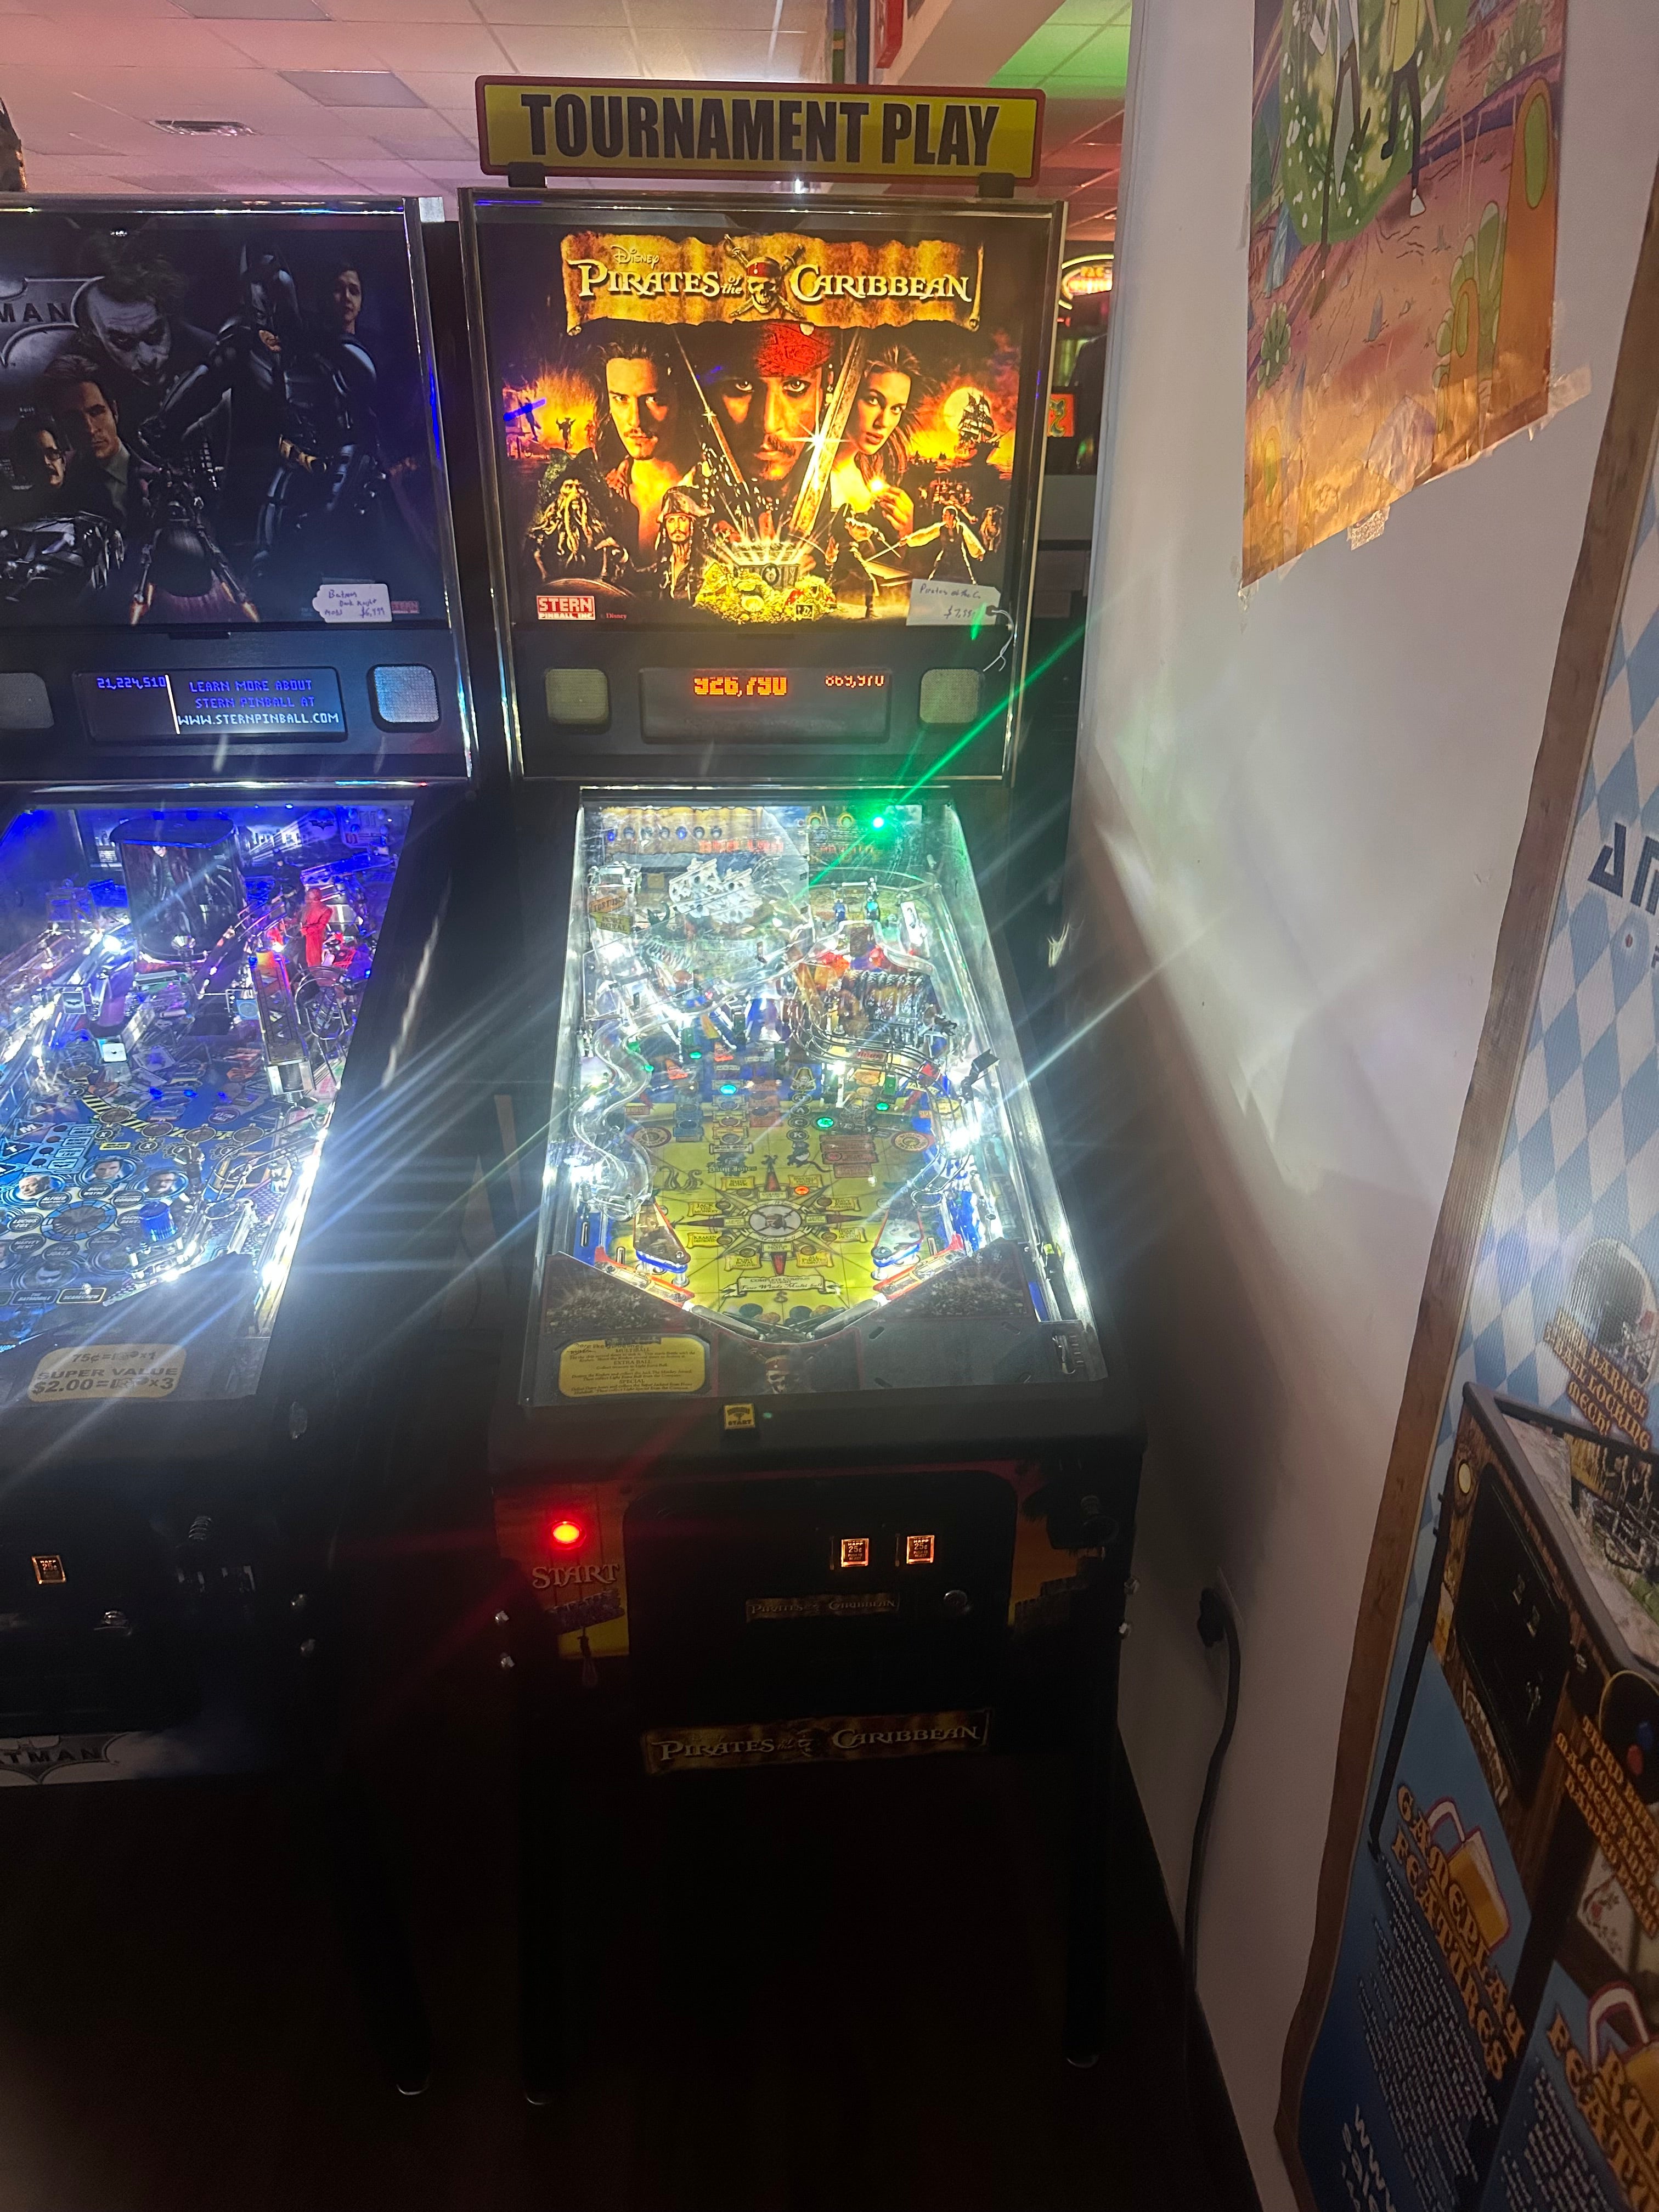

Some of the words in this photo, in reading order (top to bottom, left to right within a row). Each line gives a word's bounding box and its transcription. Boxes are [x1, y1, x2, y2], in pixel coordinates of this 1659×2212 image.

[521, 93, 870, 163] TOURNAMENT
[882, 103, 999, 166] PLAY
[566, 259, 720, 297] PIRATES
[721, 283, 742, 295] the
[788, 264, 971, 302] CARIBBEAN
[539, 597, 592, 612] STERN
[97, 676, 166, 690] 21,224,510
[189, 680, 230, 693] LEARN
[234, 679, 269, 691] MORE
[274, 679, 312, 691] ABOUT
[195, 697, 236, 709] STERN
[240, 696, 295, 708] PINBALL
[300, 696, 314, 707] AT
[178, 713, 339, 726] WWW.STERNPINBALL.COM
[38, 1369, 105, 1379] SUPER
[112, 1367, 179, 1376] VALUE
[1587, 1375, 1651, 1451] LOCKING
[532, 1564, 620, 1589] START
[653, 1738, 776, 1761] PIRATES
[832, 1726, 981, 1750] CARIBBEAN
[1397, 1782, 1526, 2059] GAMEPLAY
[1391, 1826, 1508, 2081] FEATURES
